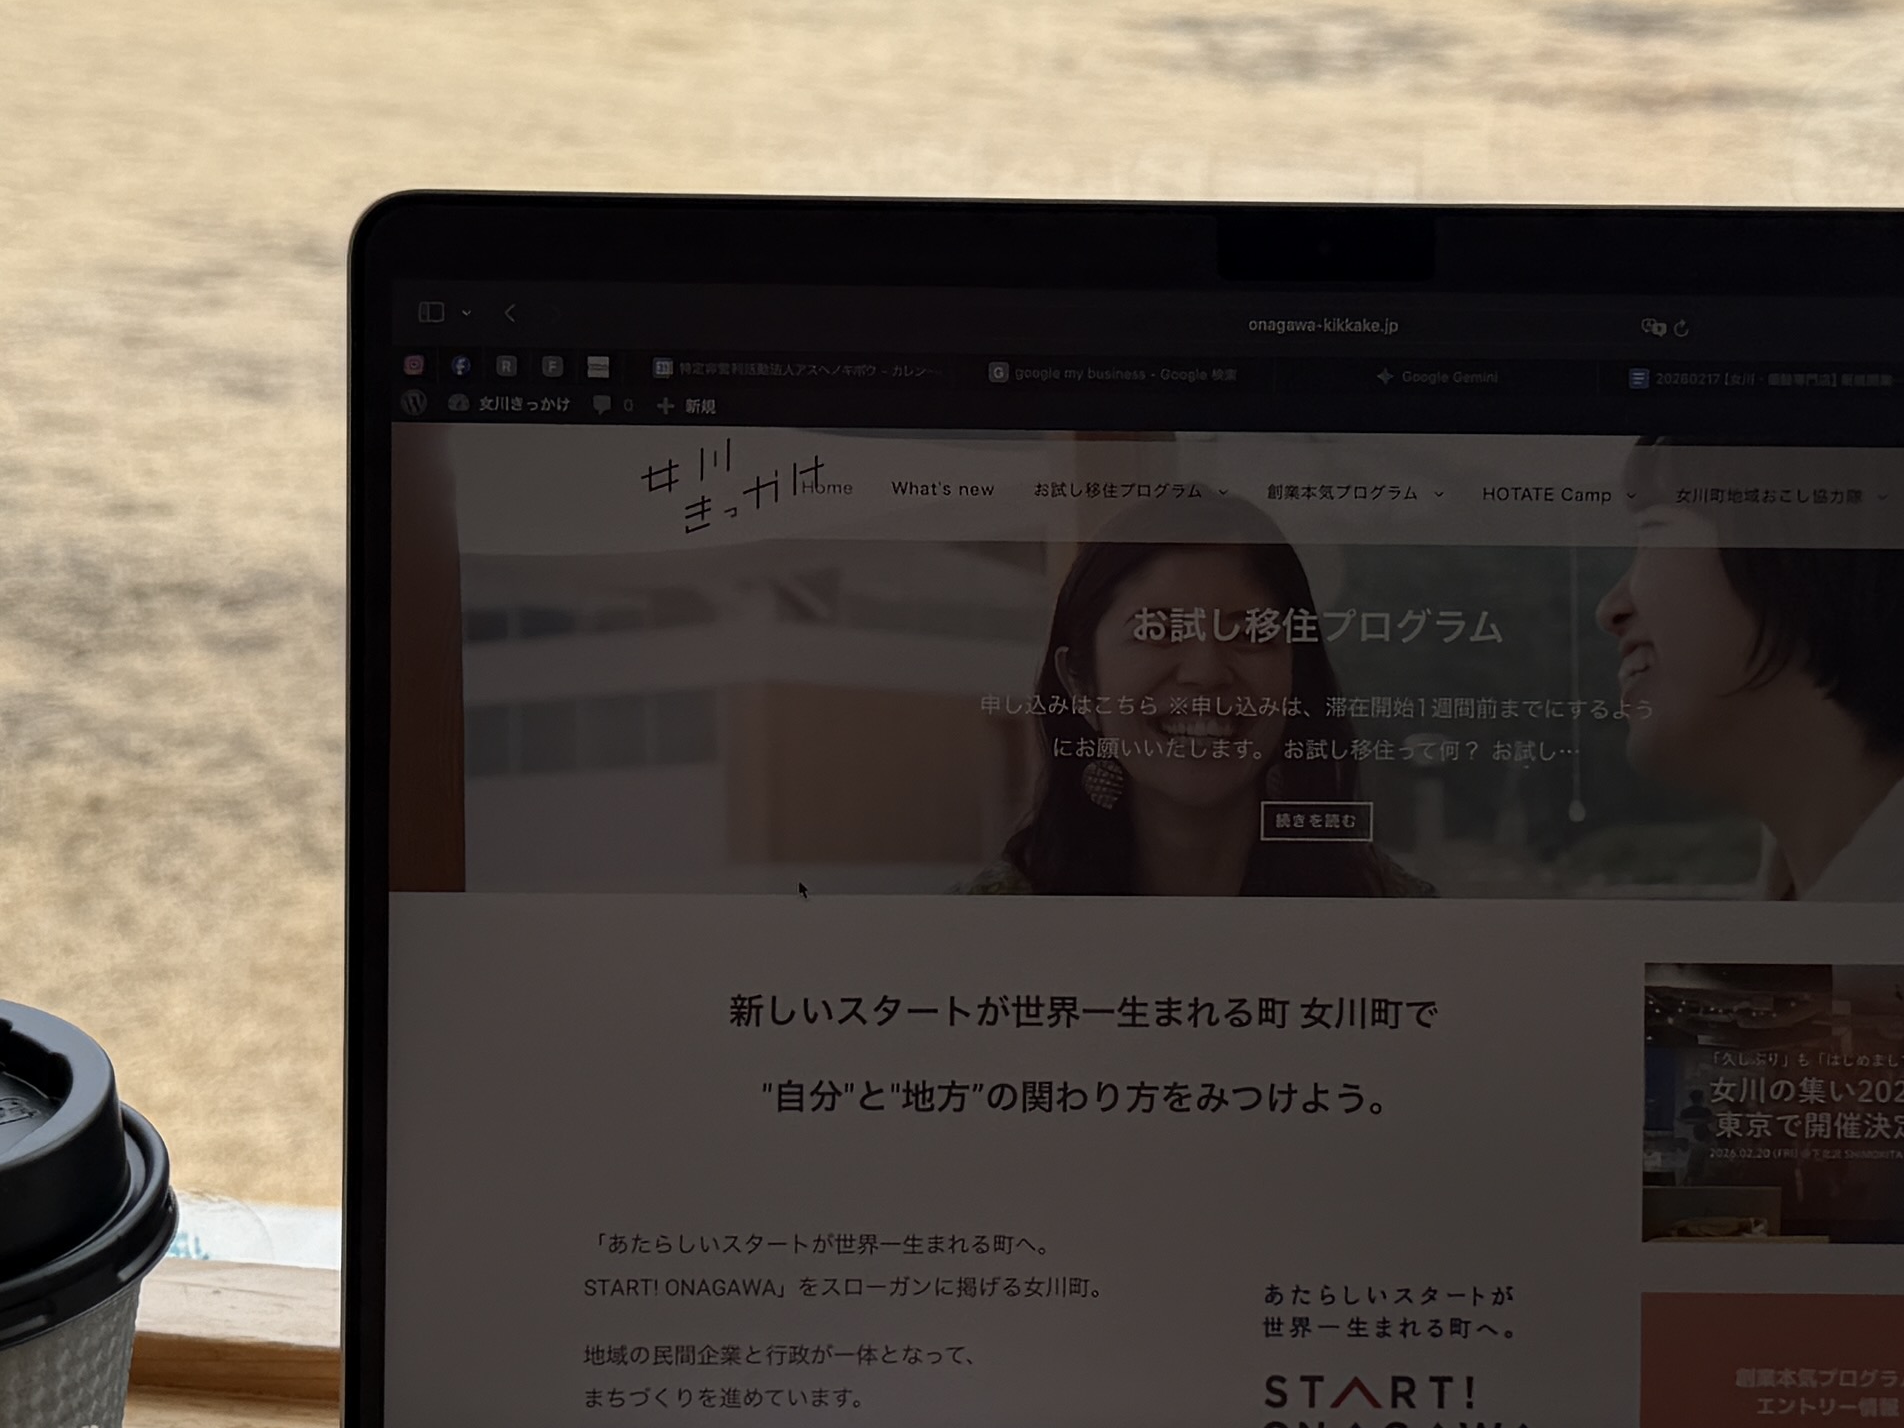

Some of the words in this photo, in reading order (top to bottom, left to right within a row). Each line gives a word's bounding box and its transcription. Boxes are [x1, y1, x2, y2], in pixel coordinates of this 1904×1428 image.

[1248, 317, 1399, 335] onagawa-kikkake.jp
[1088, 367, 1146, 381] business
[479, 396, 571, 413] 女川きっかけ
[685, 397, 717, 414] 新規
[802, 480, 853, 497] Home
[892, 481, 952, 497] What's
[959, 484, 995, 497] new
[1033, 481, 1203, 500] お試し移住プログラム
[1267, 484, 1418, 502] 創業本気プログラム
[1482, 487, 1554, 502] HOTATE
[1560, 487, 1612, 505] Camp
[1676, 486, 1864, 507] 女川町地域おこし協力隊
[1133, 606, 1504, 645] お試し移住プログラム
[980, 693, 1158, 718] 申し込みはこちら
[1052, 736, 1267, 763] にお願いいたします。
[1276, 811, 1357, 831] 続きを読む
[729, 994, 1291, 1031] 新しいスタートが世界一生まれる町
[1299, 996, 1439, 1032] 女川町で
[597, 1231, 1049, 1257] 「あたらしいスタートが世界一生まれる町へ。
[583, 1278, 659, 1298] START!
[1263, 1284, 1514, 1308] あたらしいスタートが
[1263, 1315, 1515, 1340] 世界一生まれる町へ。
[583, 1343, 975, 1368] 地域の民間企業と行政が一体となって、
[583, 1388, 864, 1411] まちづくりを進めています。
[1264, 1375, 1475, 1409] START!
